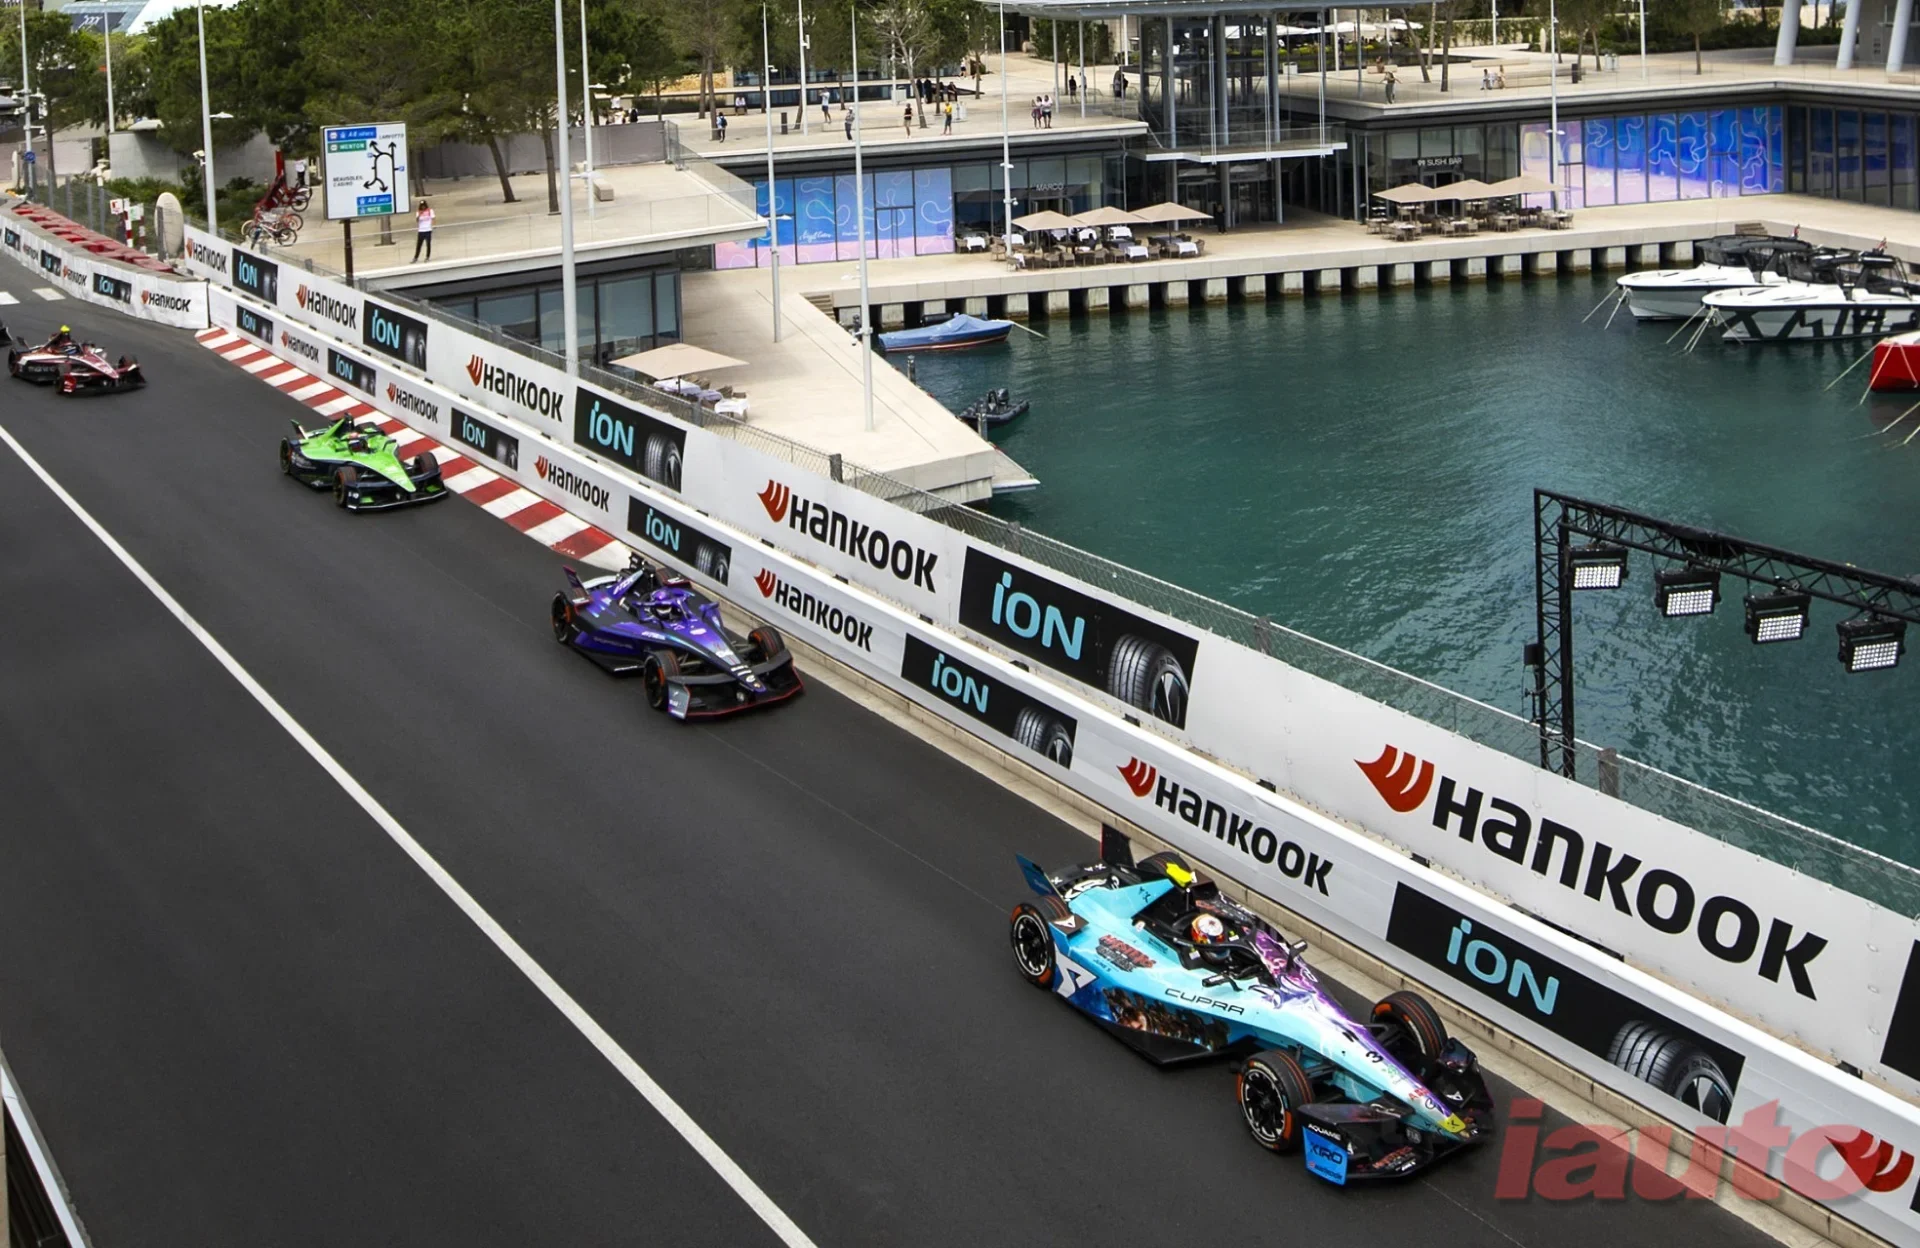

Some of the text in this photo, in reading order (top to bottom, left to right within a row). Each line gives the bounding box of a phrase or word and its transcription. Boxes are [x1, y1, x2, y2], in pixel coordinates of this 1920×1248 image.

[1427, 158, 1447, 166] SUSHI
[1448, 157, 1462, 165] BAR
[1164, 987, 1245, 1016] CUPRA
[1365, 1051, 1383, 1063] 3
